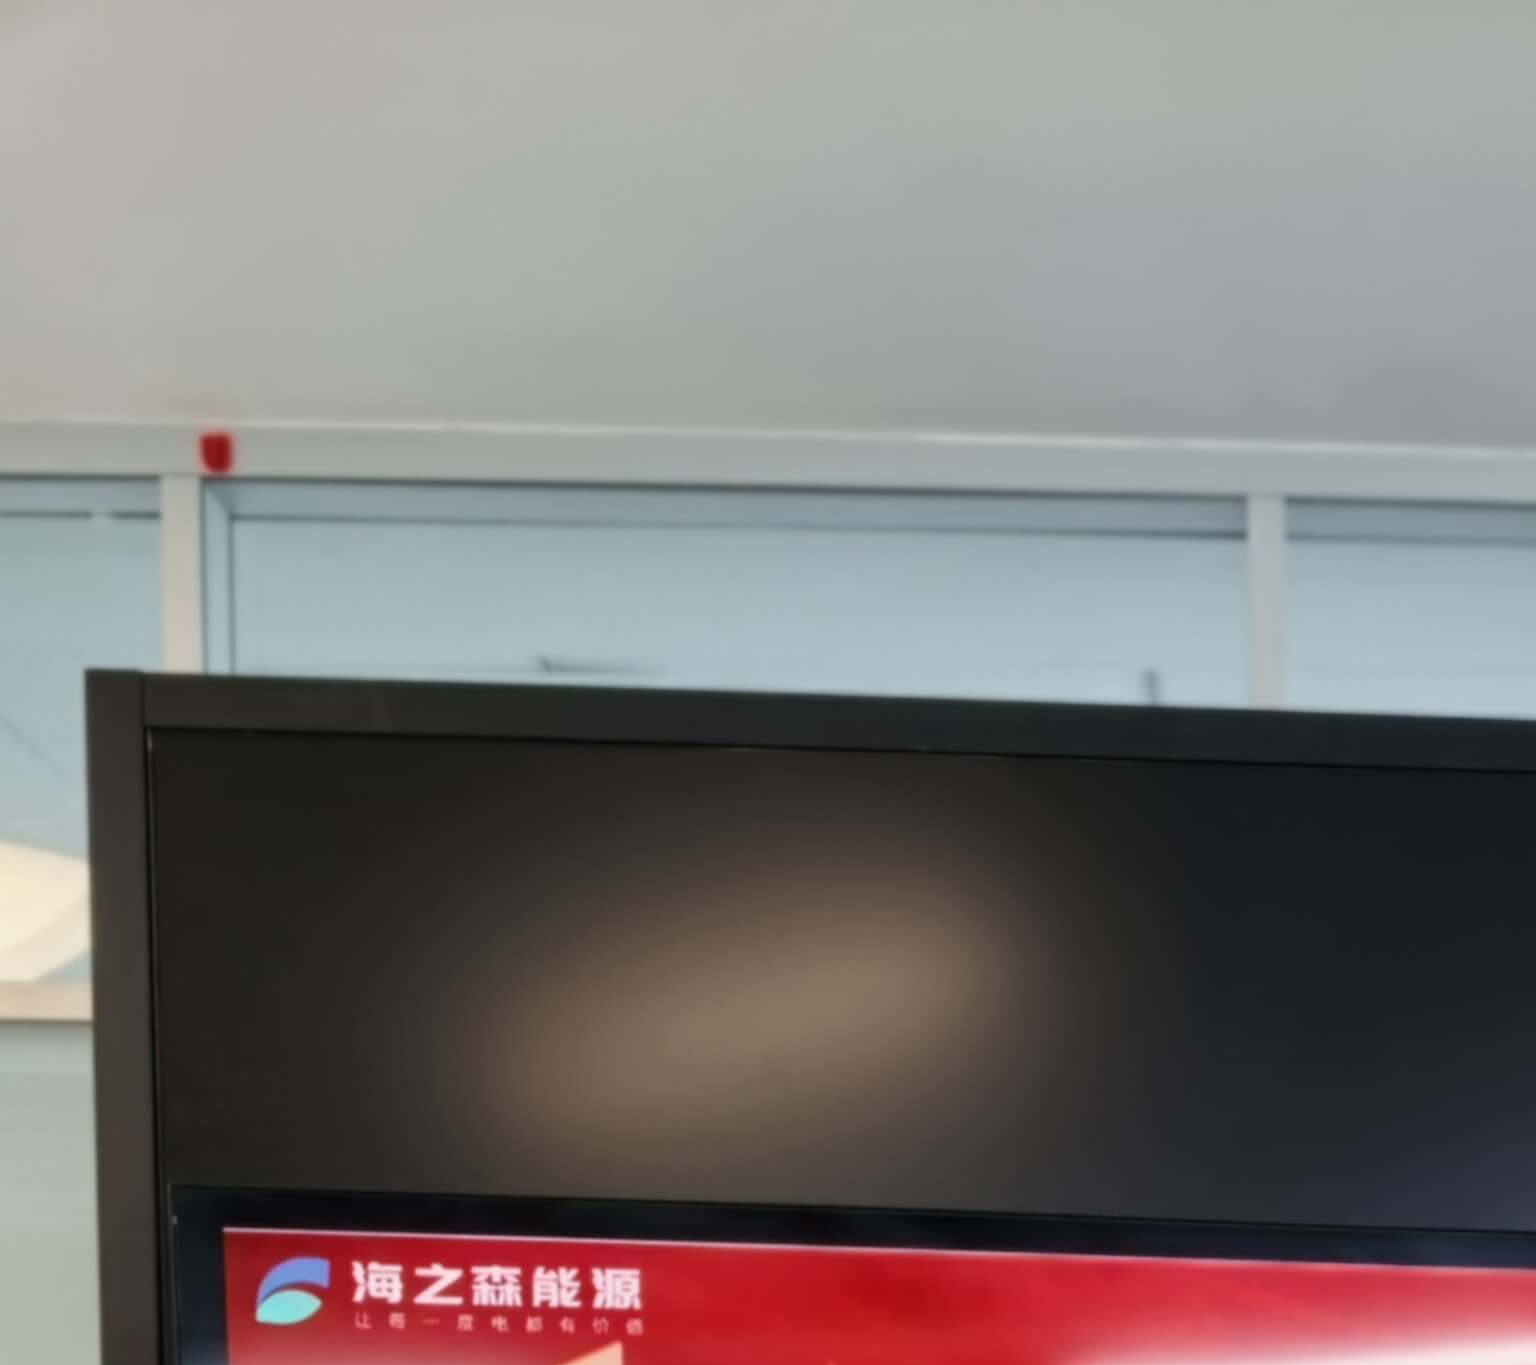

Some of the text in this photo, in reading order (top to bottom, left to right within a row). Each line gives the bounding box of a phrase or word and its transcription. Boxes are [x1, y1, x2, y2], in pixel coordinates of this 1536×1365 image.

[352, 1261, 643, 1310] 海之森能源
[354, 1312, 644, 1336] 让每一度电都有价值
